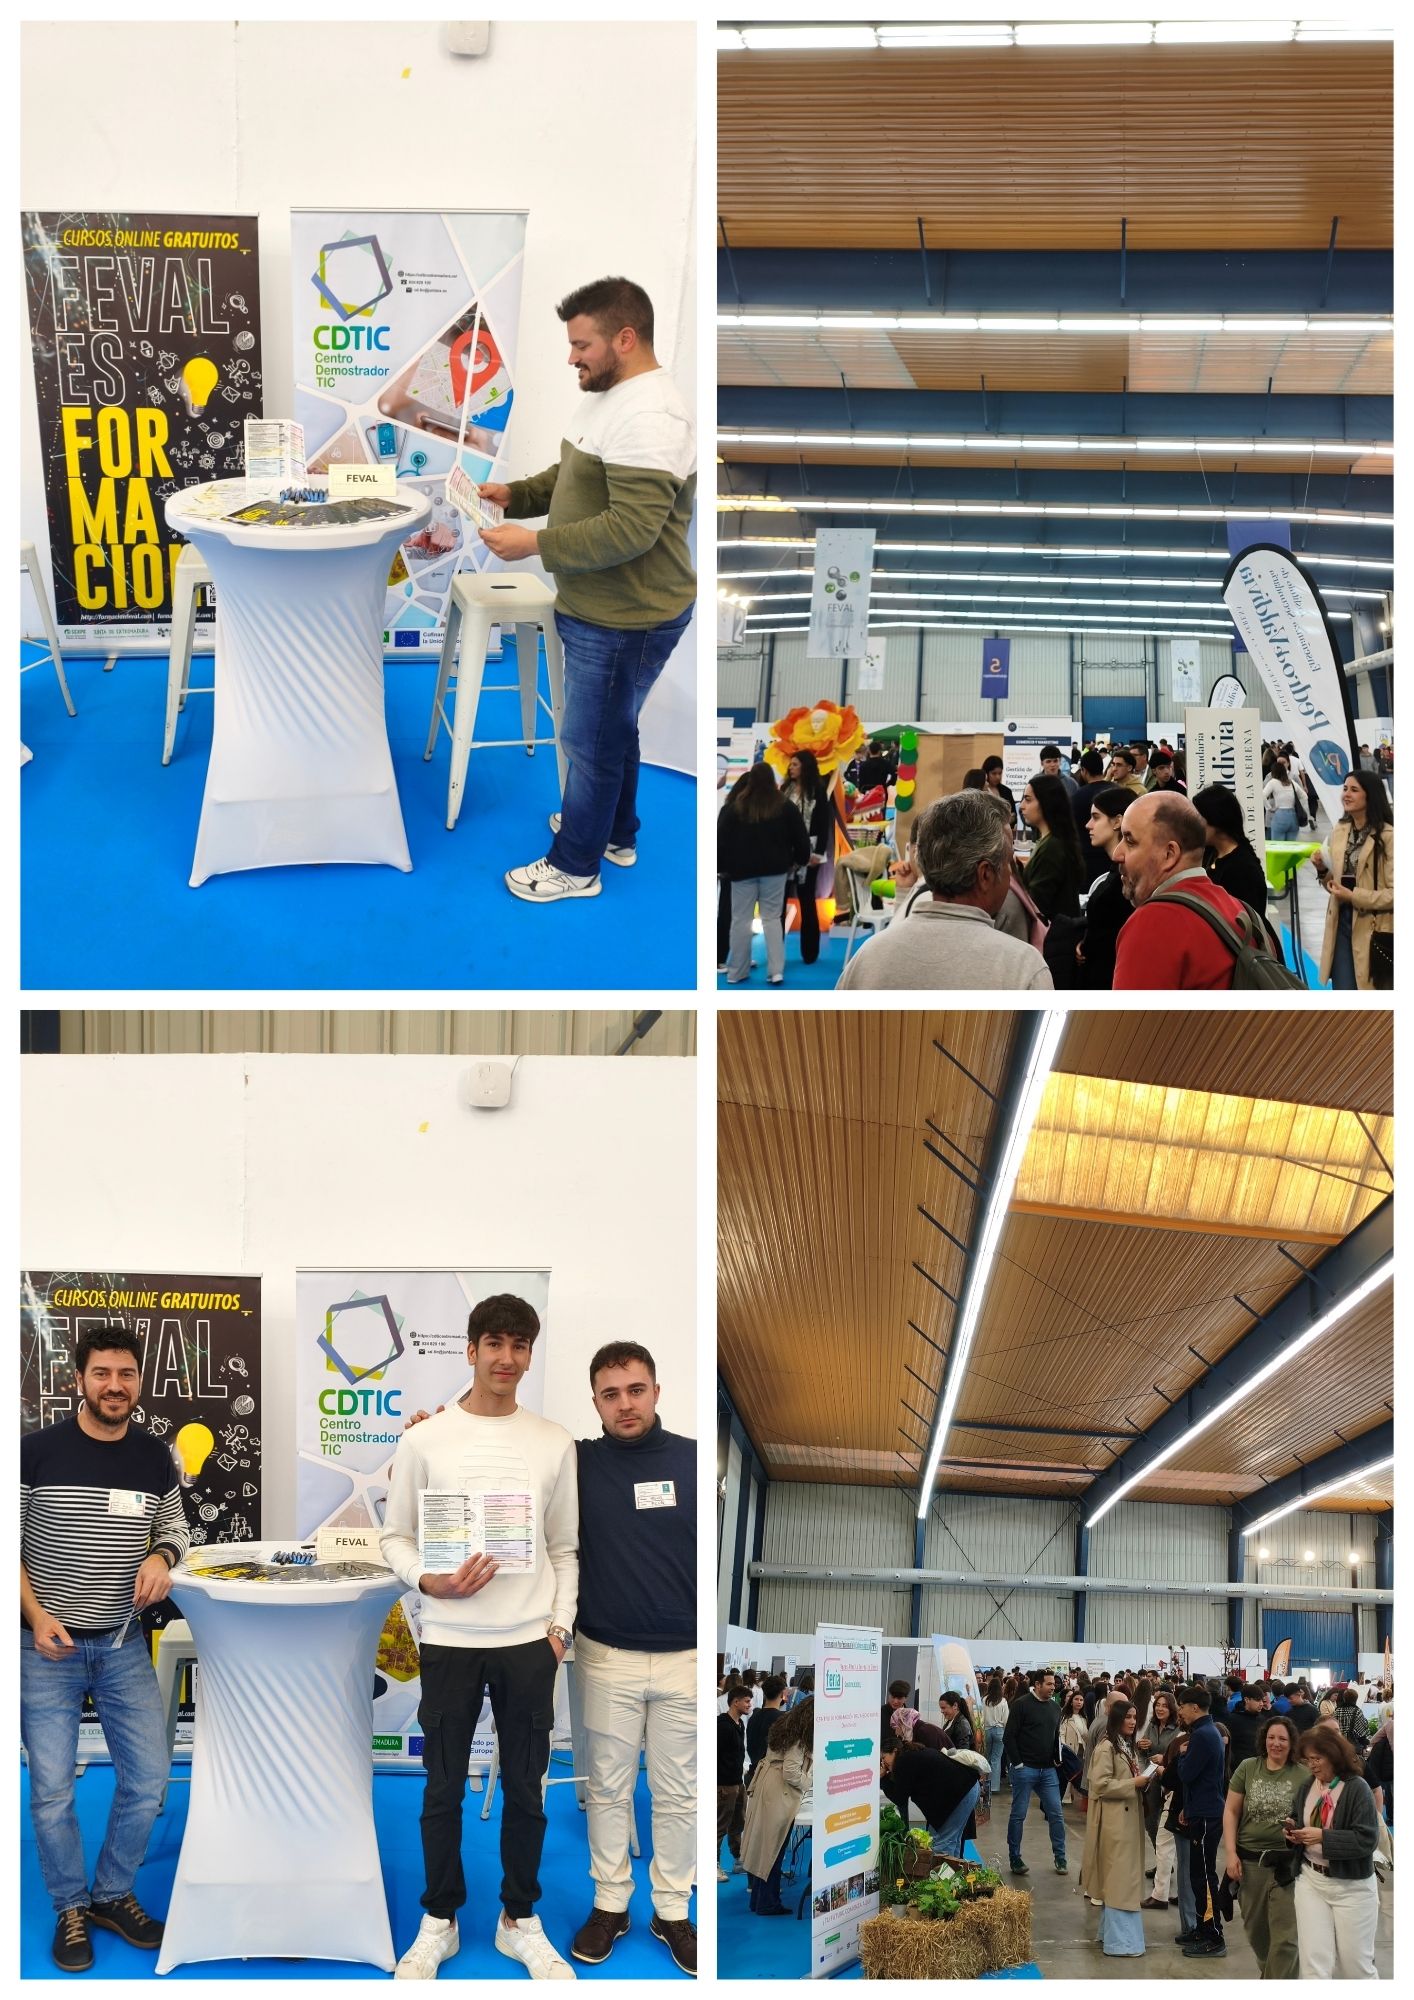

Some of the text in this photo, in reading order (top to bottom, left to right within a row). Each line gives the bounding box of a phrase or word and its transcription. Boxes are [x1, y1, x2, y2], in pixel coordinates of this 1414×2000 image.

[63, 230, 239, 249] CURSOS ONLINE GRATUITOS
[49, 255, 230, 334] FEVAL
[313, 325, 391, 351] CDTIC
[314, 353, 354, 364] Centro
[55, 332, 126, 407] ES
[315, 364, 390, 377] Demostrador
[316, 376, 336, 388] TIC
[61, 406, 174, 479] FOR
[346, 474, 379, 483] FEVAL
[67, 477, 160, 545] MA
[827, 603, 855, 613] FEVAL
[1195, 732, 1205, 790] Secundaria
[1243, 729, 1254, 778] SERENA
[1246, 784, 1255, 800] LA
[1247, 805, 1256, 822] DE
[54, 1289, 241, 1311] CURSOS ONLINE GRATUITOS
[318, 1388, 402, 1416] CDTIC
[319, 1417, 361, 1430] Centro
[320, 1430, 402, 1444] Demostrador
[321, 1444, 342, 1456] TIC
[335, 1537, 369, 1547] FEVAL
[826, 1669, 841, 1688] feria
[373, 1738, 399, 1746] EMADURA
